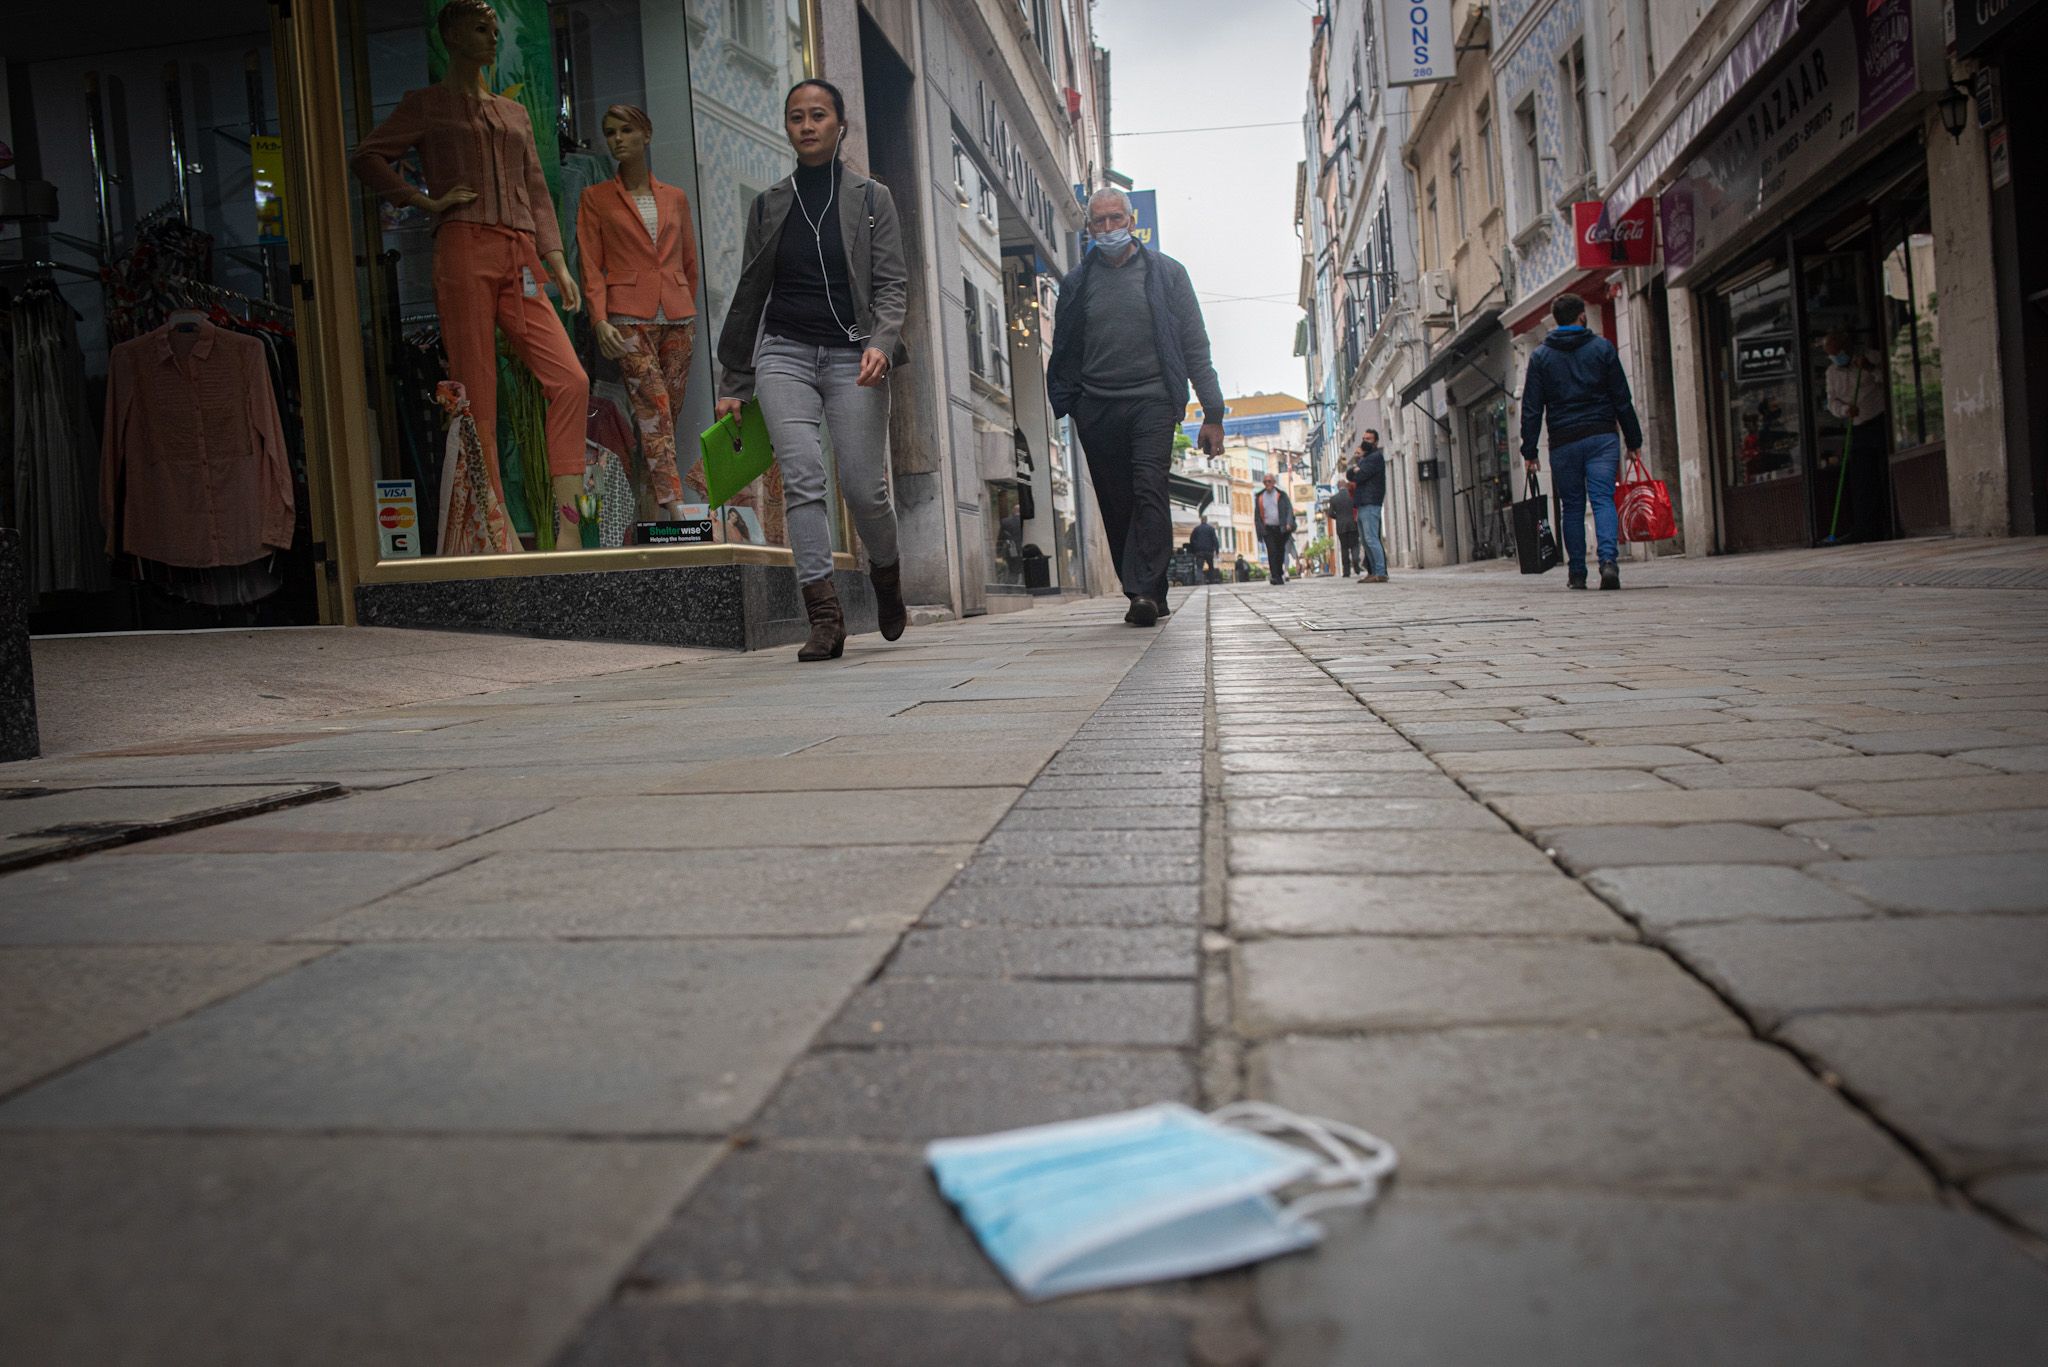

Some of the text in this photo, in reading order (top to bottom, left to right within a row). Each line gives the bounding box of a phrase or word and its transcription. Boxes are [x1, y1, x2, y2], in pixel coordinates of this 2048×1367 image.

[1410, 0, 1428, 65] ONS
[1413, 67, 1433, 77] 280
[1747, 48, 1828, 151] BAZAAR
[1839, 111, 1855, 140] 272
[1585, 219, 1644, 244] CoCola
[384, 488, 407, 498] VISA
